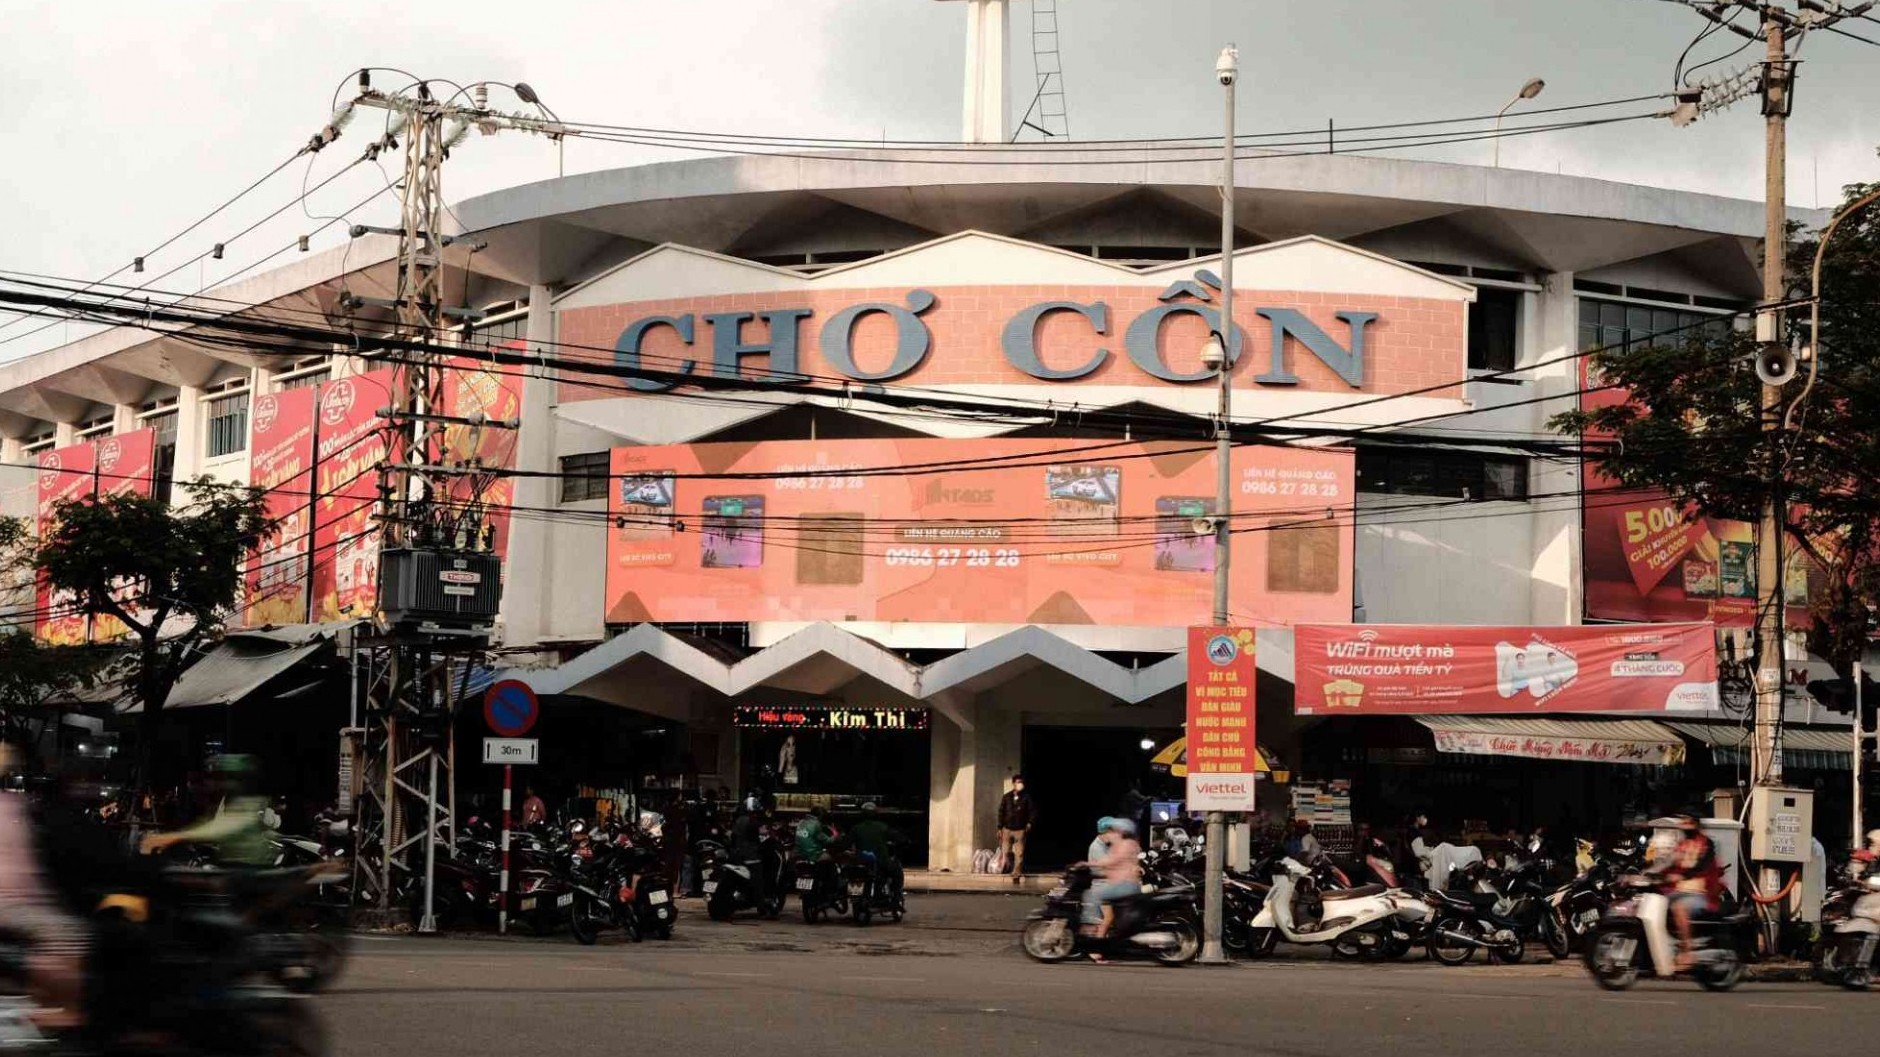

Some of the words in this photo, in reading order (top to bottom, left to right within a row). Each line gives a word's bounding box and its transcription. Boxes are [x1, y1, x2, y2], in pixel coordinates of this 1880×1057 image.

[614, 289, 935, 395] CHỢ
[1002, 269, 1379, 388] CỒN
[810, 477, 824, 489] 27
[827, 477, 845, 489] 28
[847, 477, 865, 489] 28
[1241, 481, 1277, 494] 0986
[1280, 481, 1296, 494] 27
[1302, 482, 1317, 495] 28
[1321, 483, 1338, 497] 28
[885, 549, 932, 566] 0986
[937, 549, 960, 566] 27
[966, 549, 990, 566] 28
[995, 549, 1019, 566] 28
[1326, 641, 1371, 658] WiFi
[1373, 643, 1423, 660] mượt
[1426, 643, 1455, 658] mà
[1328, 663, 1372, 676] TRÚNG
[1374, 663, 1401, 675] QUÀ
[1229, 686, 1247, 697] TIÊU
[1202, 701, 1219, 712] DÂN
[1221, 701, 1241, 712] GIÀU
[829, 711, 866, 727] Kim
[1203, 731, 1220, 743] DÂN
[1221, 731, 1240, 743] CHỦ
[501, 745, 522, 755] 30m
[1197, 745, 1220, 757] CÔNG
[1522, 740, 1553, 757] Mừng
[1556, 740, 1583, 757] Năm
[1219, 761, 1242, 772] MINH
[1196, 783, 1247, 794] viettel
